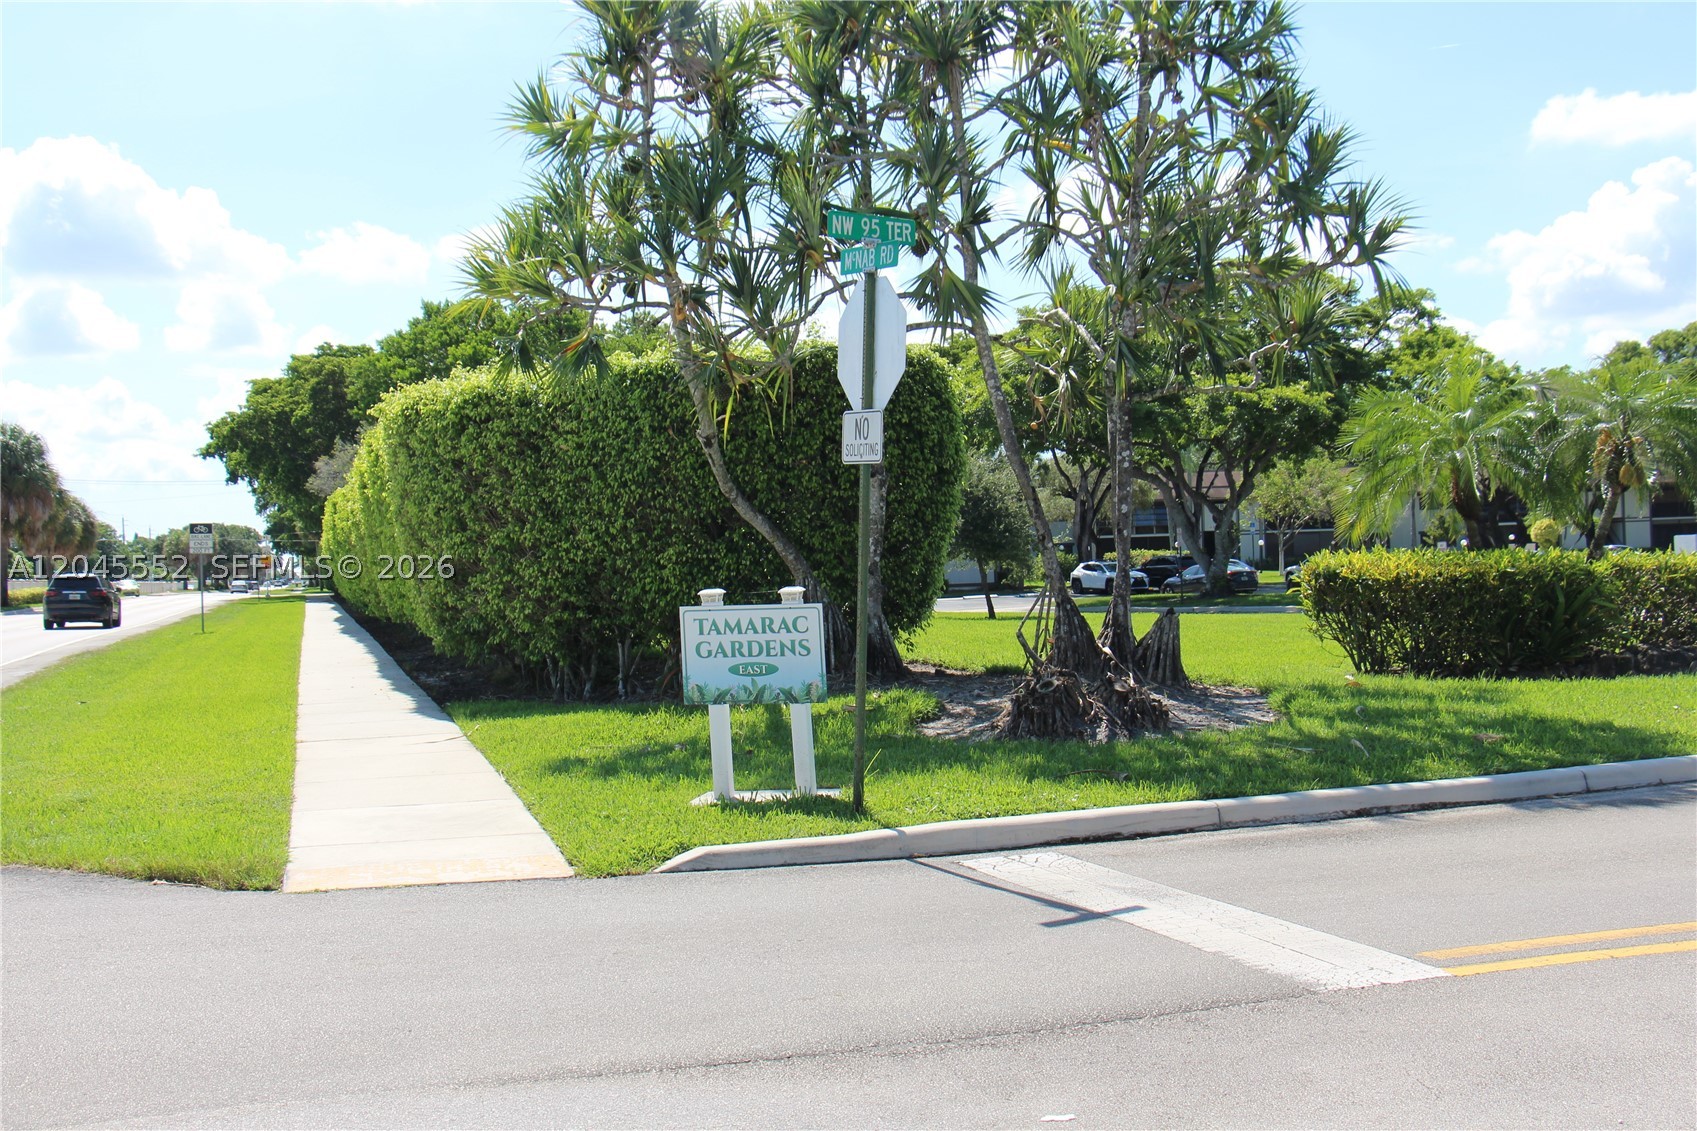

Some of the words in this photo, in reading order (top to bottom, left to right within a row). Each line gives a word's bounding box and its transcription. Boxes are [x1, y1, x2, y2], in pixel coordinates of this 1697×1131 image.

[832, 214, 854, 236] NW
[861, 217, 880, 238] 95
[886, 220, 912, 243] TER
[880, 244, 894, 266] RD
[854, 416, 870, 441] NO
[845, 442, 879, 457] SOLICITING
[693, 615, 809, 636] TAMARAC
[695, 638, 811, 659] GARDENS
[739, 664, 768, 675] EAST
